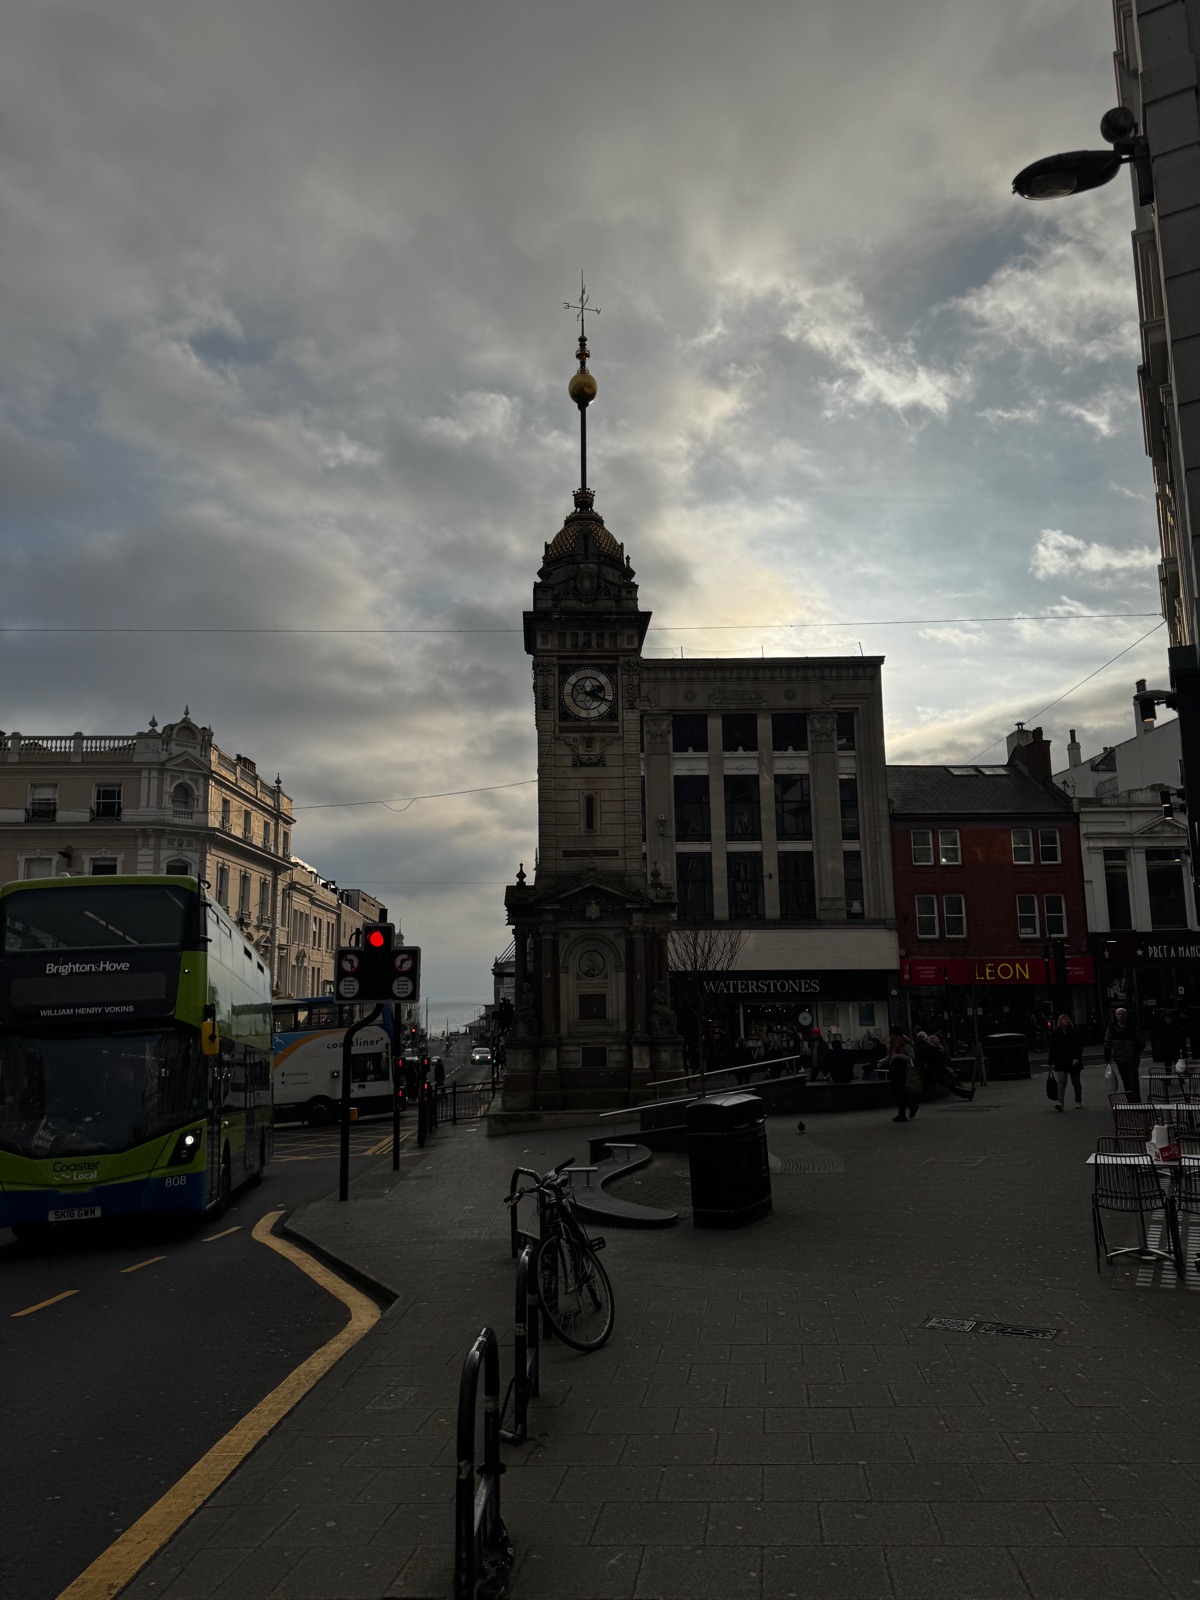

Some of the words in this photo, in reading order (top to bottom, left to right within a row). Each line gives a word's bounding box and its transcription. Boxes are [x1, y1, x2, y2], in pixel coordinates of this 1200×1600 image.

[1148, 945, 1168, 958] PRET
[1170, 945, 1177, 958] A
[45, 961, 130, 976] Brighton&Hove
[975, 962, 1030, 980] LEON
[703, 979, 820, 993] WATERSTONES
[40, 1008, 74, 1017] WILLIAM
[75, 1006, 103, 1015] HENRY
[104, 1005, 134, 1013] VOKINS
[326, 1038, 381, 1049] coatliner
[53, 1161, 100, 1172] Coaster
[74, 1170, 97, 1180] Local
[164, 1175, 187, 1188] 808
[54, 1209, 74, 1219] SK16
